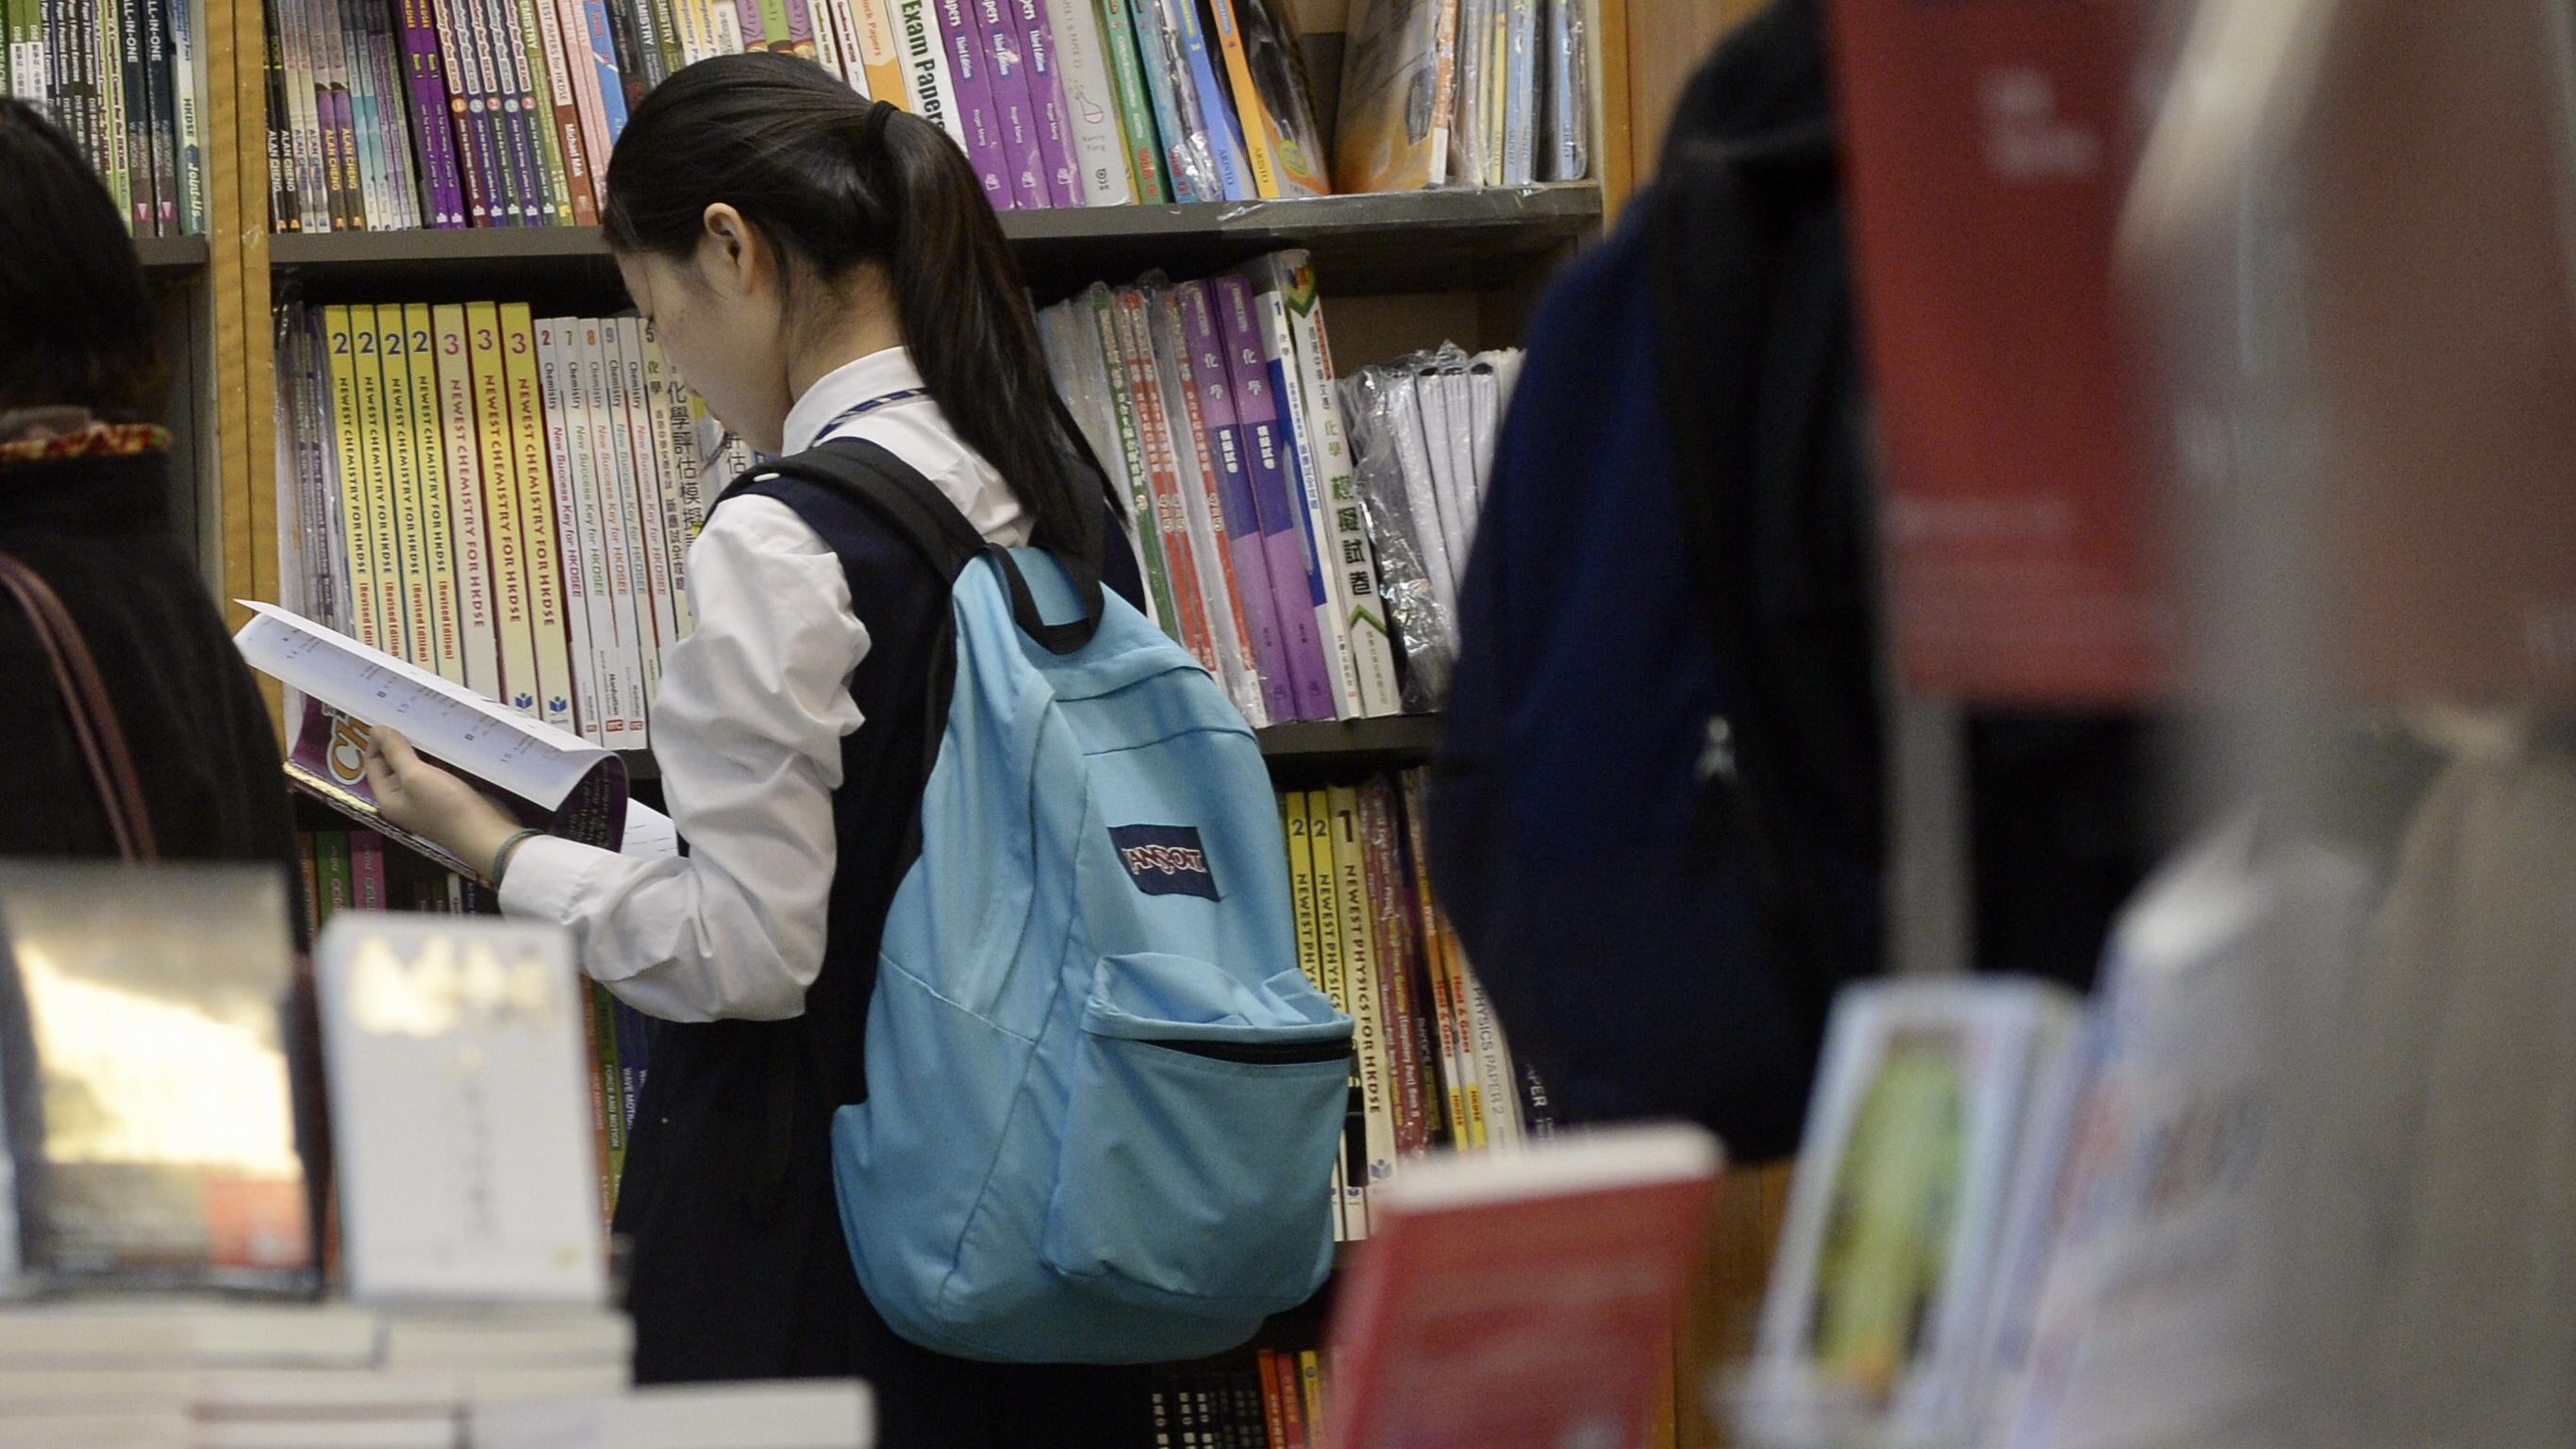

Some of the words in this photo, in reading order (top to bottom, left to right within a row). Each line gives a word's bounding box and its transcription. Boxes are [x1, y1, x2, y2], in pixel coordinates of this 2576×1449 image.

[520, 0, 539, 48] EMISTRY
[541, 2, 551, 20] TEST
[636, 0, 654, 45] EMISTRY
[656, 0, 674, 44] EMISTRY
[147, 0, 162, 61] LL-IN-ONE
[547, 25, 558, 55] PAPERS
[868, 23, 883, 57] Papers
[956, 36, 968, 54] Third
[993, 34, 1005, 51] Third
[1030, 30, 1042, 47] Third
[553, 58, 561, 70] for
[902, 1, 928, 58] Exam
[915, 58, 946, 130] Papers
[960, 55, 972, 78] Edition
[996, 52, 1009, 75] Edition
[1033, 48, 1045, 72] Edition
[557, 73, 567, 99] HKDSE
[183, 98, 194, 138] HKDSE
[268, 130, 278, 157] ALAN
[281, 130, 291, 157] ALAN
[325, 130, 336, 157] ALAN
[342, 128, 353, 155] ALAN
[564, 124, 581, 158] Michael
[272, 158, 282, 192] CHENG
[284, 158, 294, 192] CHENG
[328, 158, 340, 191] CHENG
[345, 157, 357, 189] CHENG
[572, 158, 583, 177] Mak
[187, 162, 202, 218] Joint-Us
[1274, 301, 1282, 316] 1
[332, 332, 349, 354] 2
[358, 332, 374, 354] 2
[385, 334, 402, 355] 2
[413, 331, 428, 353] 2
[444, 334, 459, 356] 3
[477, 329, 492, 350] 3
[511, 333, 526, 354] 3
[542, 330, 551, 345] 2
[544, 363, 556, 410] Chemistry
[570, 362, 581, 409] Chemistry
[590, 362, 602, 409] Chemistry
[609, 359, 622, 408] Chemistry
[628, 361, 641, 409] Chemistry
[1204, 353, 1224, 400] 化學
[1241, 347, 1263, 396] 化學
[340, 378, 351, 425] NEWEST
[365, 377, 377, 425] NEWEST
[392, 378, 404, 426] NEWEST
[419, 376, 431, 424] NEWEST
[451, 380, 466, 441] NEWEST
[485, 375, 500, 436] NEWEST
[519, 379, 534, 440] NEWEST
[553, 427, 562, 452] New
[617, 424, 625, 448] New
[636, 425, 645, 450] New
[1324, 421, 1342, 458] 化學
[345, 430, 358, 501] CHEMISTRY
[370, 429, 385, 501] CHEMISTRY
[397, 431, 411, 503] CHEMISTRY
[424, 428, 438, 499] CHEMISTRY
[557, 456, 567, 500] Success
[579, 455, 590, 499] Success
[602, 454, 612, 499] Success
[621, 452, 630, 497] Success
[640, 453, 651, 498] Success
[667, 381, 703, 547] 化學評估模擬
[457, 445, 475, 536] CHEMISTRY
[492, 441, 509, 531] CHEMISTRY
[525, 444, 544, 535] CHEMISTRY
[377, 506, 387, 529] FOR
[406, 508, 415, 530] FOR
[432, 505, 443, 527] FOR
[562, 505, 572, 525] Key
[585, 504, 594, 525] Key
[607, 503, 617, 524] Key
[624, 502, 636, 522] Key
[645, 504, 656, 524] Key
[565, 531, 575, 544] for
[588, 529, 596, 543] for
[611, 528, 621, 541] for
[630, 526, 639, 540] for
[650, 528, 660, 541] for
[1331, 475, 1371, 597] 模擬試卷
[355, 534, 366, 575] HKDSE
[380, 533, 391, 574] HKDSE
[407, 535, 419, 575] HKDSE
[434, 532, 445, 572] HKDSE
[466, 541, 479, 571] FOR
[502, 537, 514, 566] FOR
[536, 541, 549, 570] FOR
[359, 583, 372, 621] (Revised
[385, 582, 397, 621] (Revised
[412, 584, 425, 624] (Revised
[439, 581, 451, 622] (Revised
[470, 576, 484, 627] HKDSE
[506, 571, 521, 623] HKDSE
[540, 575, 555, 626] HKDSE
[364, 622, 374, 647] Editi
[417, 626, 428, 661] Edition)
[443, 624, 455, 659] Edition)
[1292, 820, 1305, 836] 2
[1314, 820, 1326, 837] 2
[1338, 810, 1353, 842] 1
[1297, 874, 1313, 937] NEWEST
[1319, 874, 1335, 937] NEWEST
[1345, 865, 1363, 933] NEWEST
[1326, 943, 1341, 1008] PHYSICS
[1354, 940, 1370, 1010] PHYSICS
[1453, 975, 1464, 1004] Heat
[1461, 1022, 1471, 1055] Gases
[1362, 1017, 1373, 1050] FOR
[1471, 988, 1494, 1051] PHYSICS
[1483, 1056, 1502, 1104] PAPER
[606, 1065, 615, 1093] FORCE
[623, 1067, 634, 1092] WAVE
[1365, 1057, 1380, 1114] HKDSE
[1526, 1065, 1548, 1107] APER
[607, 1095, 617, 1113] AND
[609, 1114, 619, 1147] MOTION
